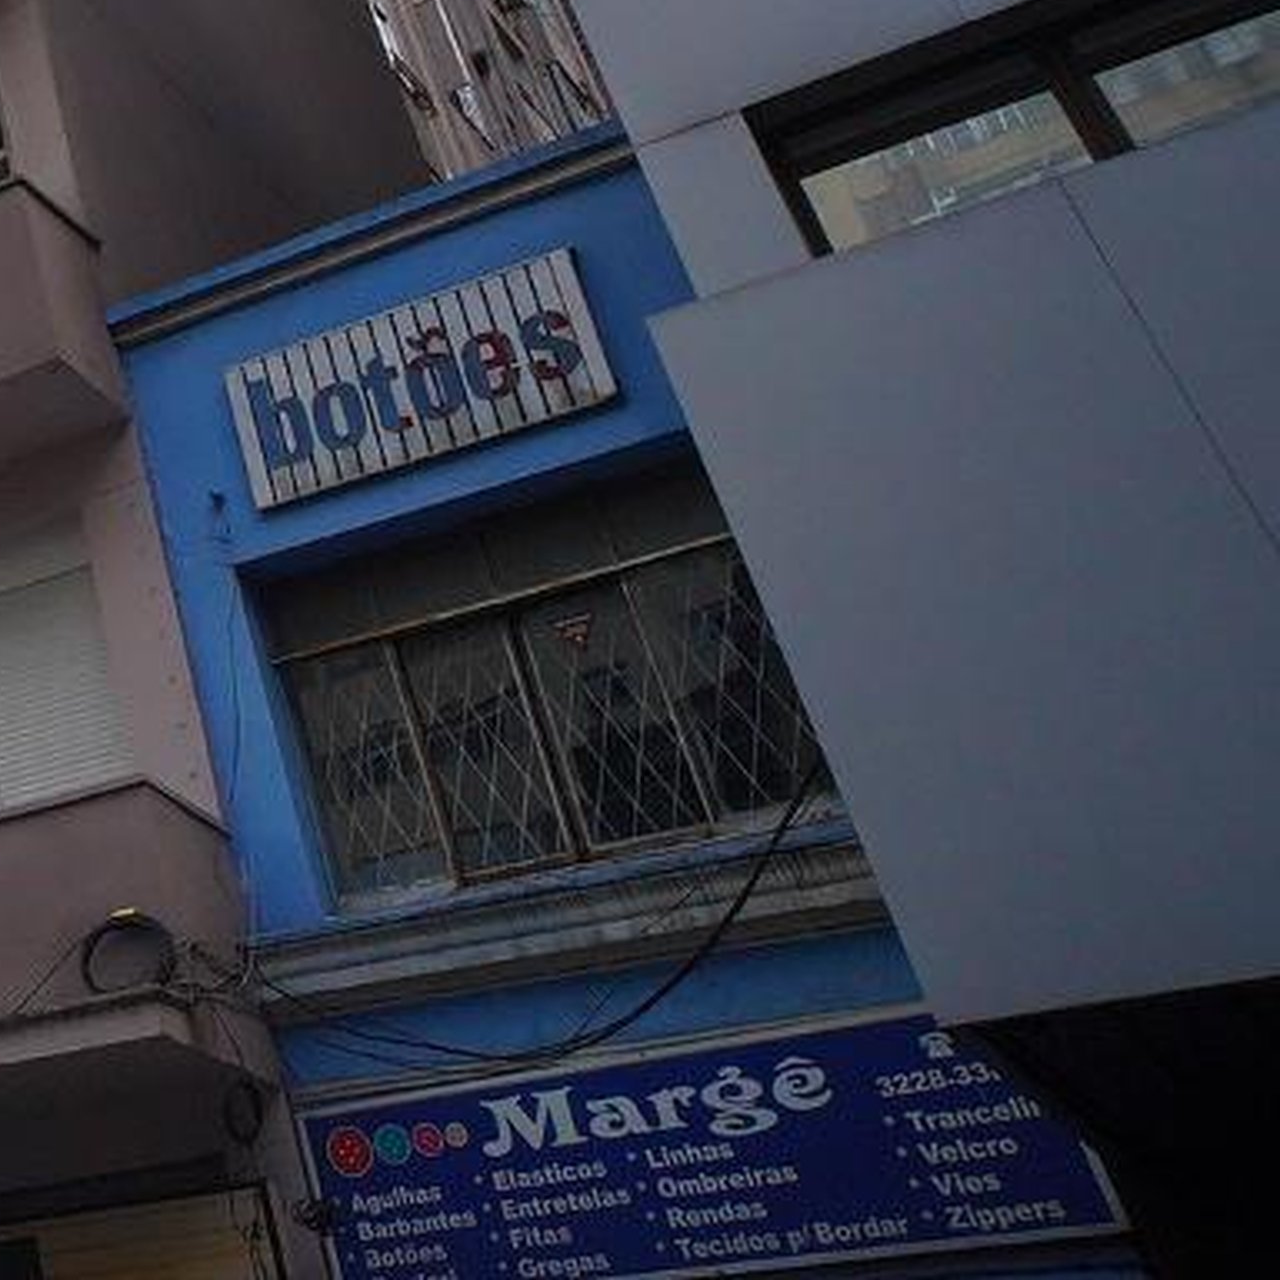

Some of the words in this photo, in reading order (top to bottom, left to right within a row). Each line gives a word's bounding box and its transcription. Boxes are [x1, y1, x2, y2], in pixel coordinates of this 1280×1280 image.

[480, 1056, 835, 1159] Margê
[644, 1139, 735, 1170] Linhas
[914, 1137, 1020, 1166] Velcro
[655, 1162, 800, 1201] Ombreiras
[813, 1212, 910, 1245] Bordar
[941, 1196, 1068, 1231] Zippers
